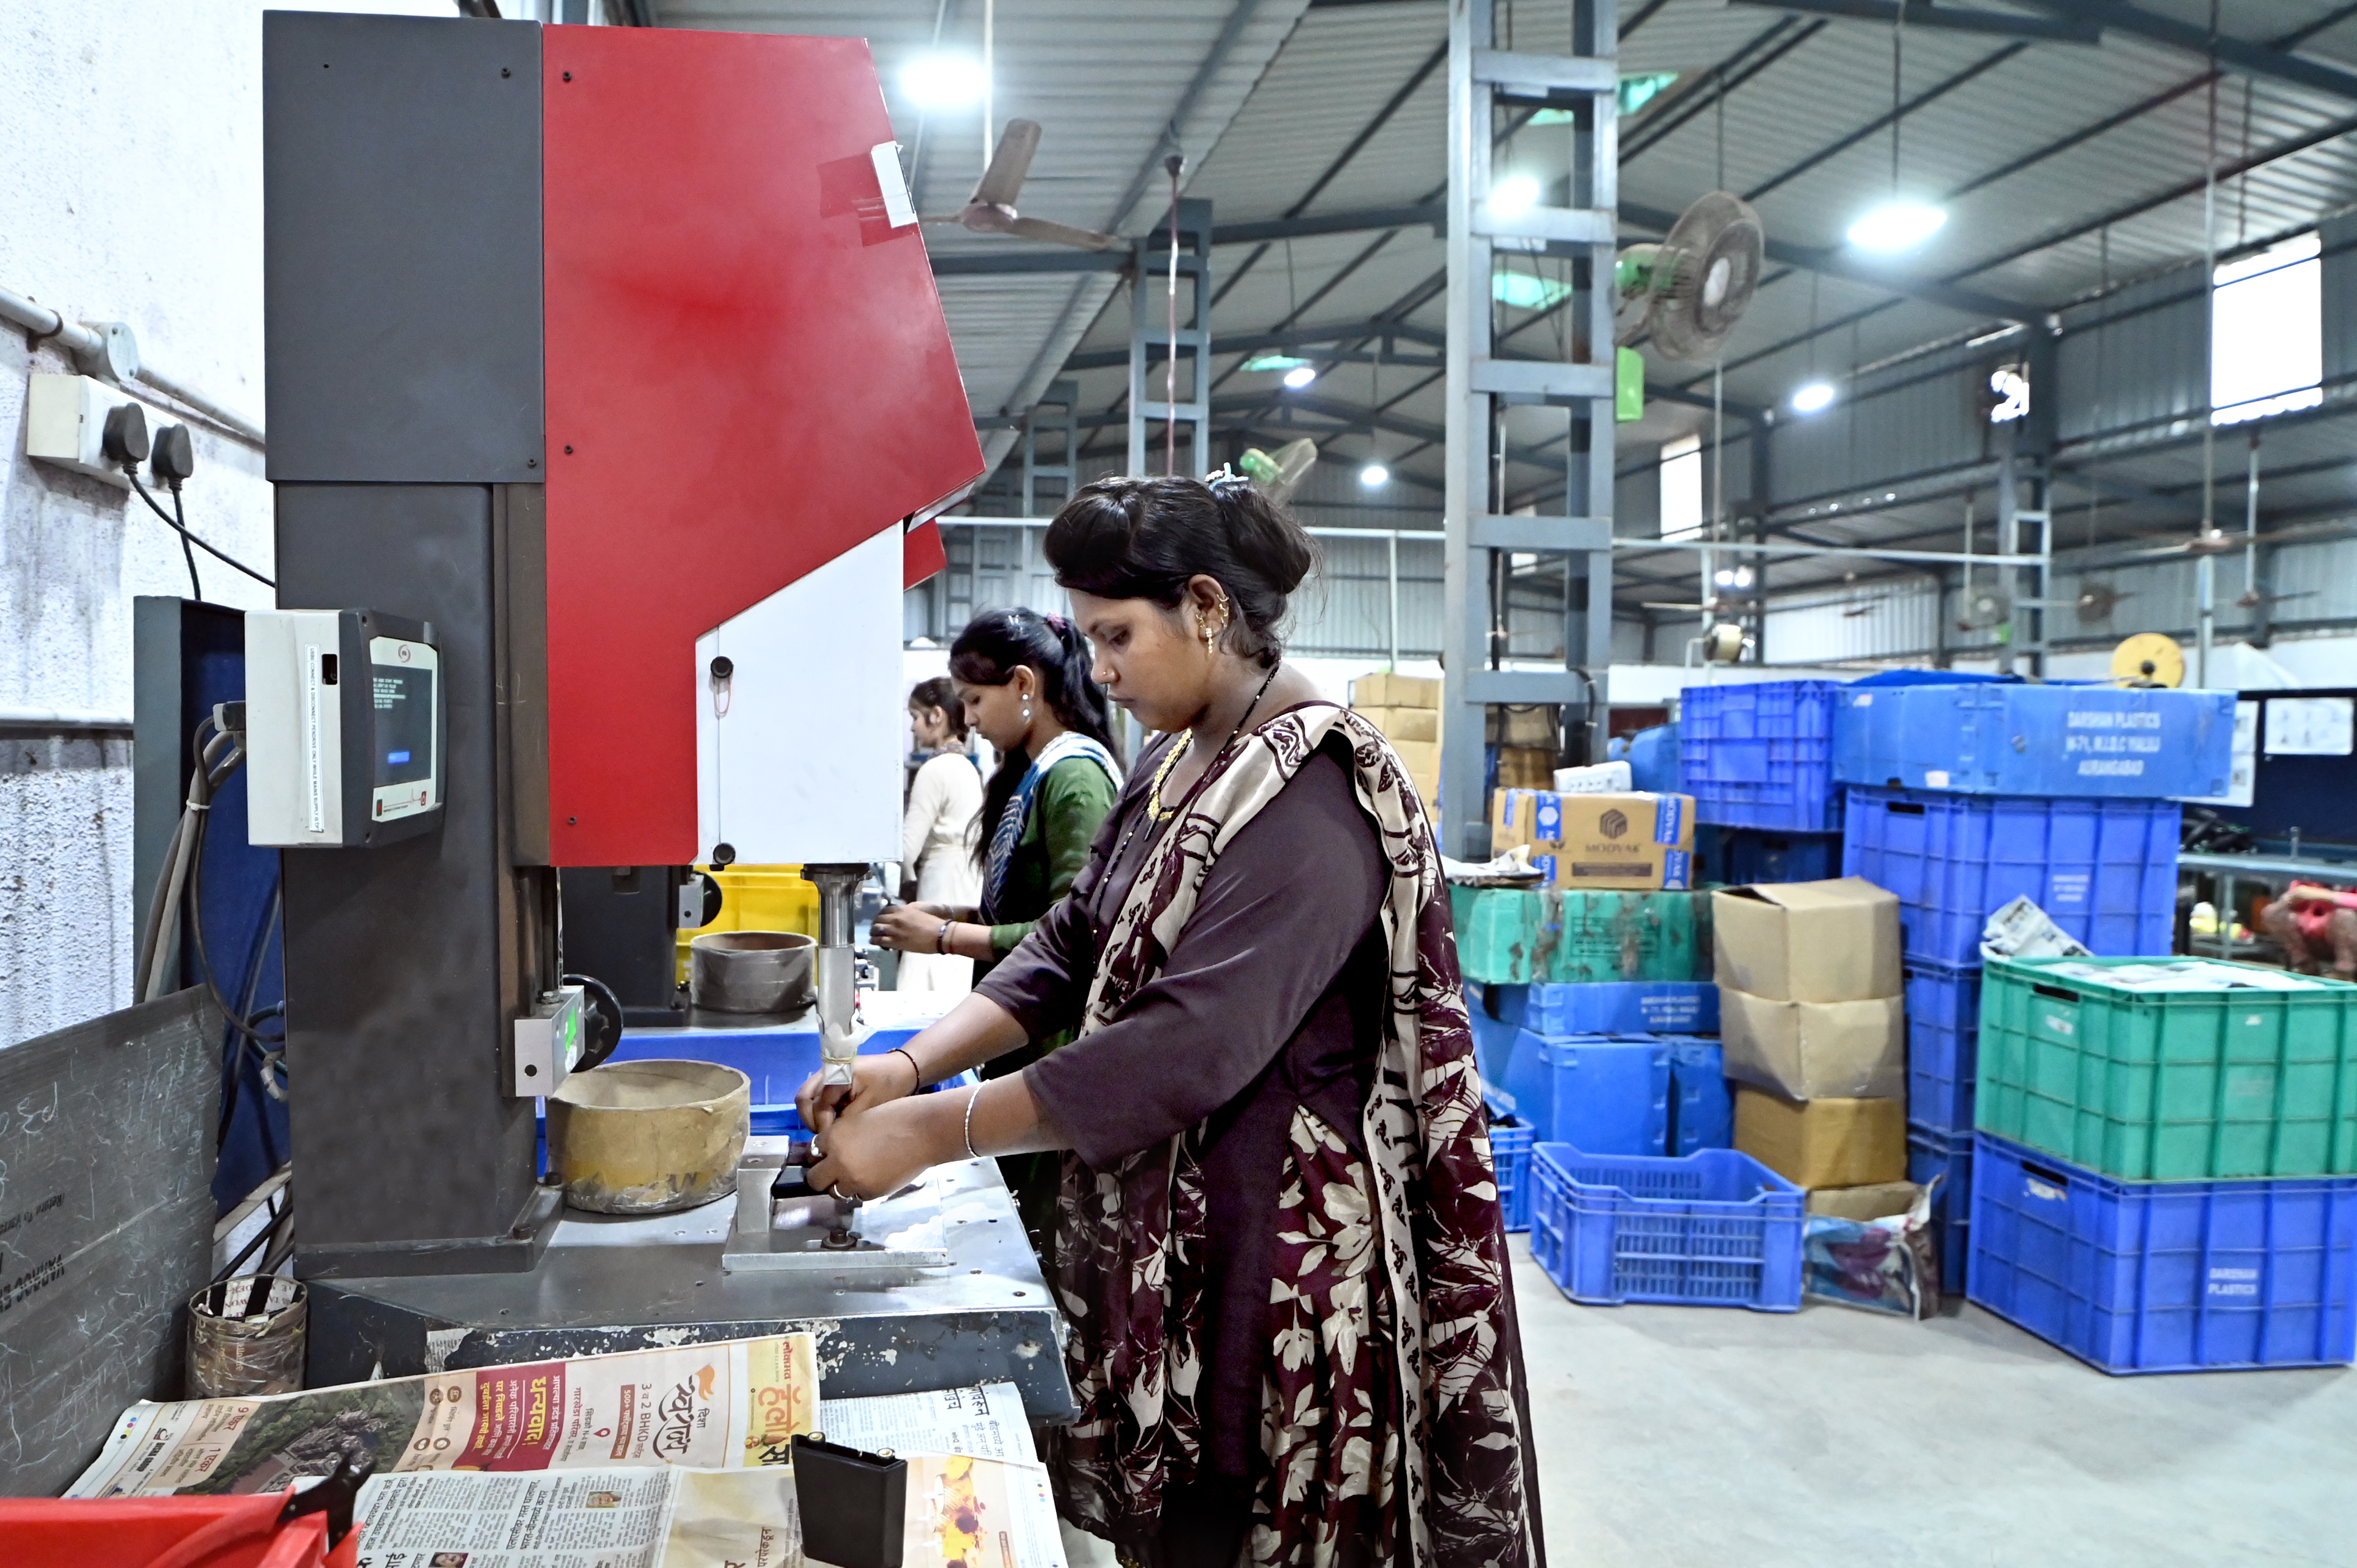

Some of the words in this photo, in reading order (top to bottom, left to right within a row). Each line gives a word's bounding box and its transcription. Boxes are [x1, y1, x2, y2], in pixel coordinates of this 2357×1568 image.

[783, 1342, 793, 1380] लोकमत
[481, 1382, 491, 1410] दुबईला
[496, 1380, 504, 1392] घर
[509, 1379, 519, 1399] अनेक
[495, 1393, 505, 1421] निवडले
[521, 1376, 547, 1446] धन्यवाद!
[573, 1386, 583, 1416] गारखेडा
[223, 1415, 245, 1431] एकर
[479, 1411, 489, 1434] जायची
[507, 1400, 519, 1433] परिवारांनी
[551, 1405, 561, 1420] उदंड
[584, 1408, 594, 1429] सिडको
[697, 1408, 710, 1428] दिशा
[491, 1423, 502, 1437] आणि
[568, 1418, 581, 1439] परिसर,
[637, 1413, 651, 1442] BHKD
[971, 1421, 986, 1431] मुंडे
[989, 1420, 1004, 1444] बीडमध्ये
[194, 1454, 218, 1472] एकर
[376, 1491, 389, 1501] भरा
[523, 1480, 541, 1504] घालणार,
[517, 1505, 530, 1518] गस्त
[520, 1506, 542, 1550] भारत-चीनमध्ये
[536, 1490, 548, 1505] करार
[364, 1537, 377, 1551] आज
[505, 1519, 525, 1550] एलएसीवर
[755, 1527, 774, 1567] परंपरेकडून
